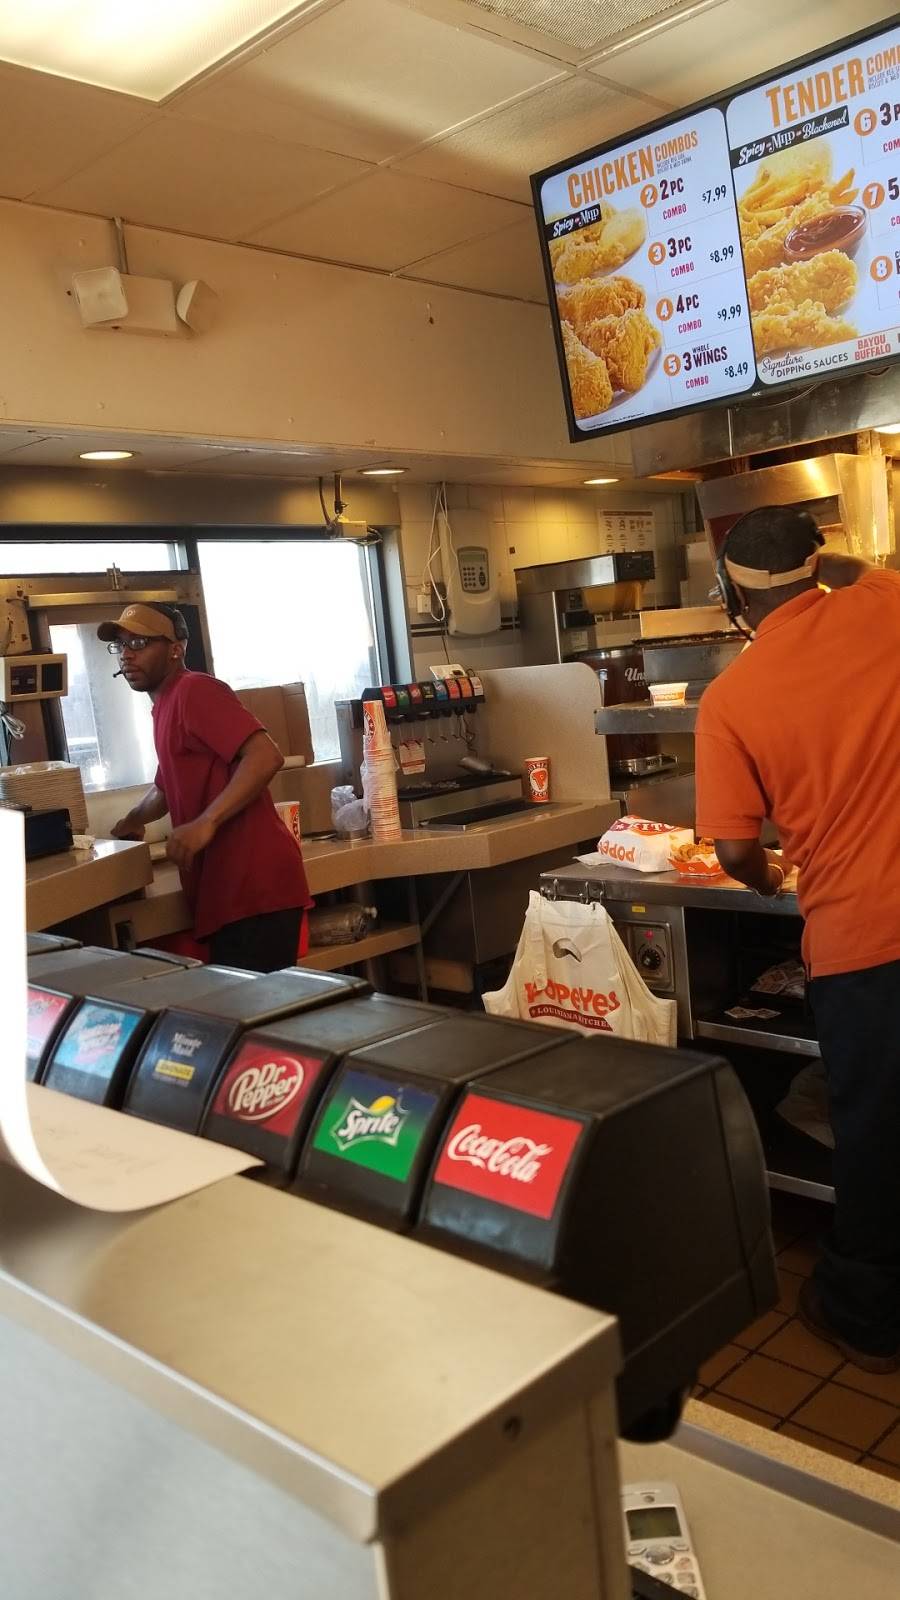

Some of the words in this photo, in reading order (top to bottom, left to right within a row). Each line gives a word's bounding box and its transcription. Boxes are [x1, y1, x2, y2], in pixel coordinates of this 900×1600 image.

[765, 57, 865, 128] TENDER
[739, 141, 766, 165] Spicy
[802, 109, 848, 139] Blackened
[567, 144, 655, 209] CHICKEN
[655, 130, 698, 162] COMBOS
[702, 185, 727, 204] $7.99
[662, 203, 688, 220] COMBO
[553, 219, 574, 237] Spicy
[709, 245, 734, 263] $8.99
[670, 261, 695, 278] COMBO
[717, 304, 742, 321] $9.99
[678, 319, 702, 334] COMBO
[857, 334, 886, 350] BAYOU
[854, 343, 891, 361] BUFFALO
[682, 351, 692, 371] 3
[693, 346, 728, 369] WINGS
[724, 361, 749, 379] $8.49
[762, 351, 804, 377] Signature
[776, 361, 812, 378] DIPPING
[814, 352, 849, 369] SAUCES
[685, 375, 709, 389] COMBO
[257, 1062, 287, 1088] Dr
[232, 1067, 298, 1113] Pepper
[338, 1109, 399, 1139] Sprite
